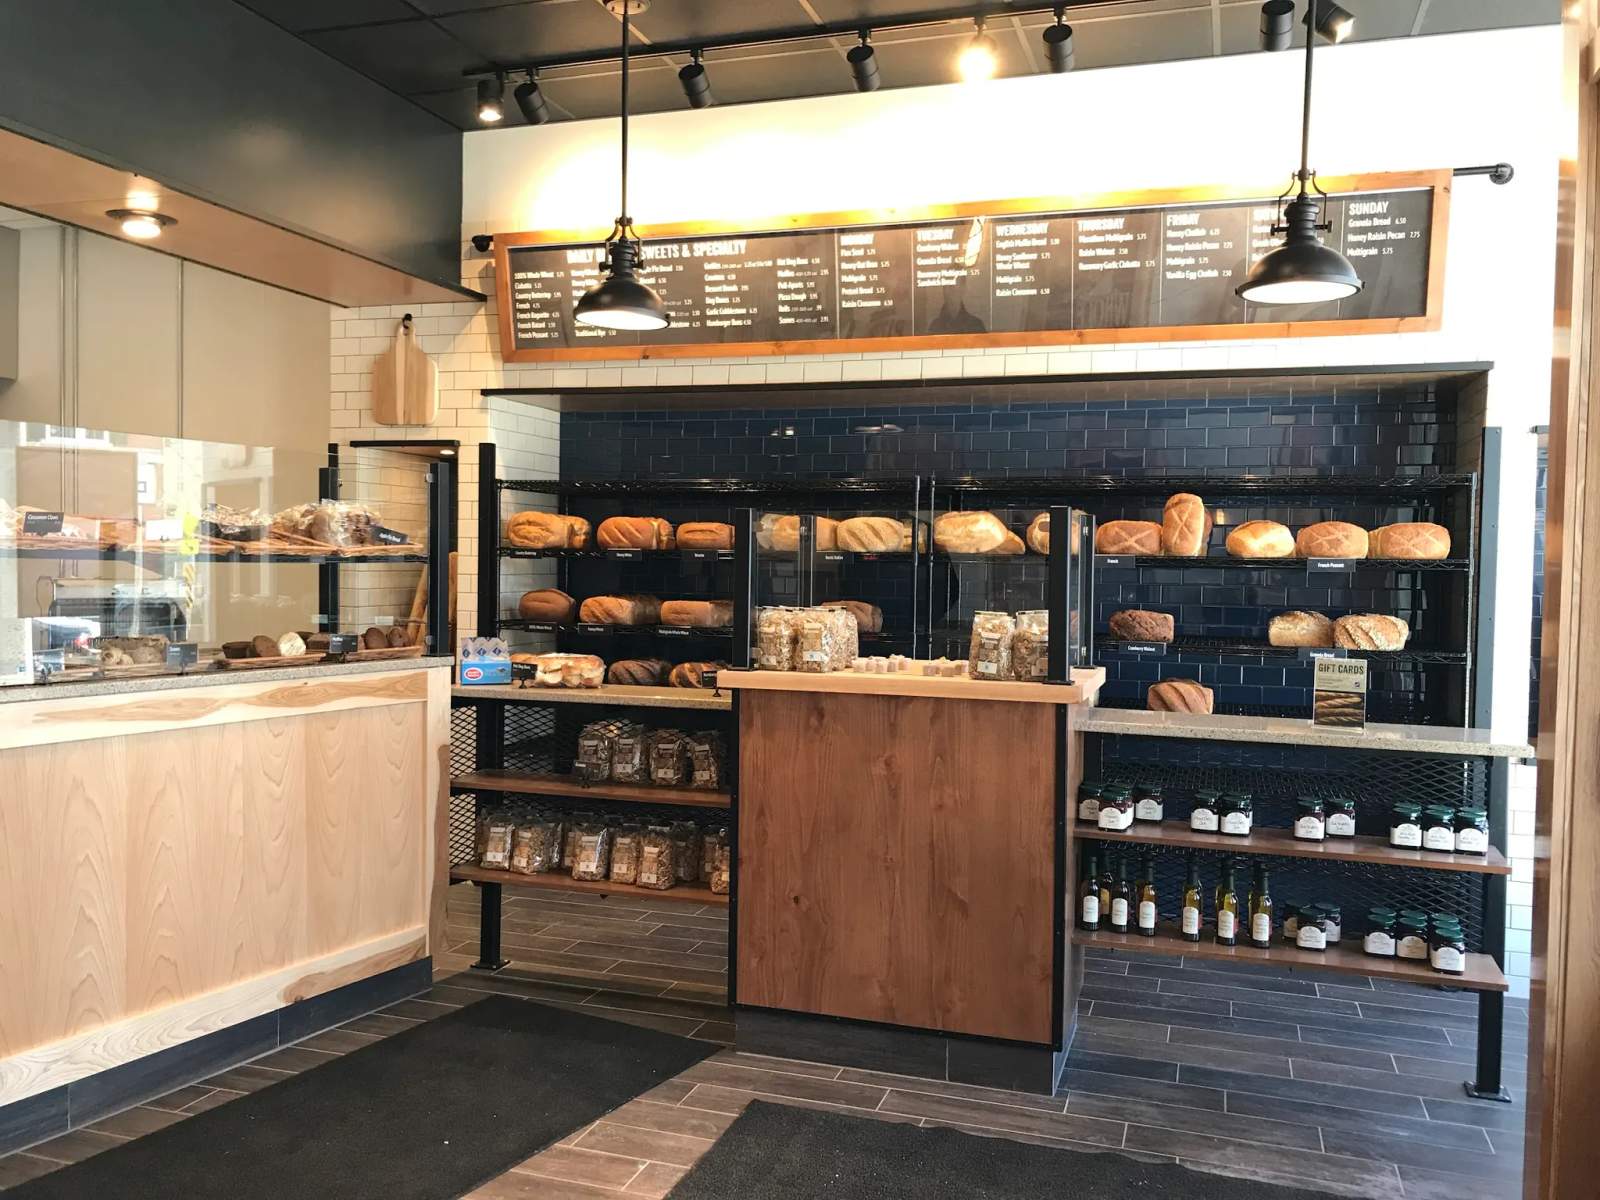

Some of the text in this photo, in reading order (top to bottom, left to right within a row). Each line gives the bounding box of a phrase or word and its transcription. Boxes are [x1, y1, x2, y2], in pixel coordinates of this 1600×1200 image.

[1349, 201, 1390, 215] SUNDAY
[1078, 218, 1125, 232] THURSDAY
[1167, 213, 1200, 226] FRIDAY
[1348, 218, 1371, 228] Granola
[1373, 218, 1391, 226] Bread
[996, 222, 1048, 236] WEDNESDAY
[1348, 233, 1367, 243] Honey
[1368, 232, 1386, 241] Raisin
[1387, 231, 1406, 240] Pecan
[640, 240, 746, 260] SWEETS & SPECIALTY
[1347, 248, 1378, 258] Multigrain
[1318, 663, 1364, 674] GIFT CARDS
